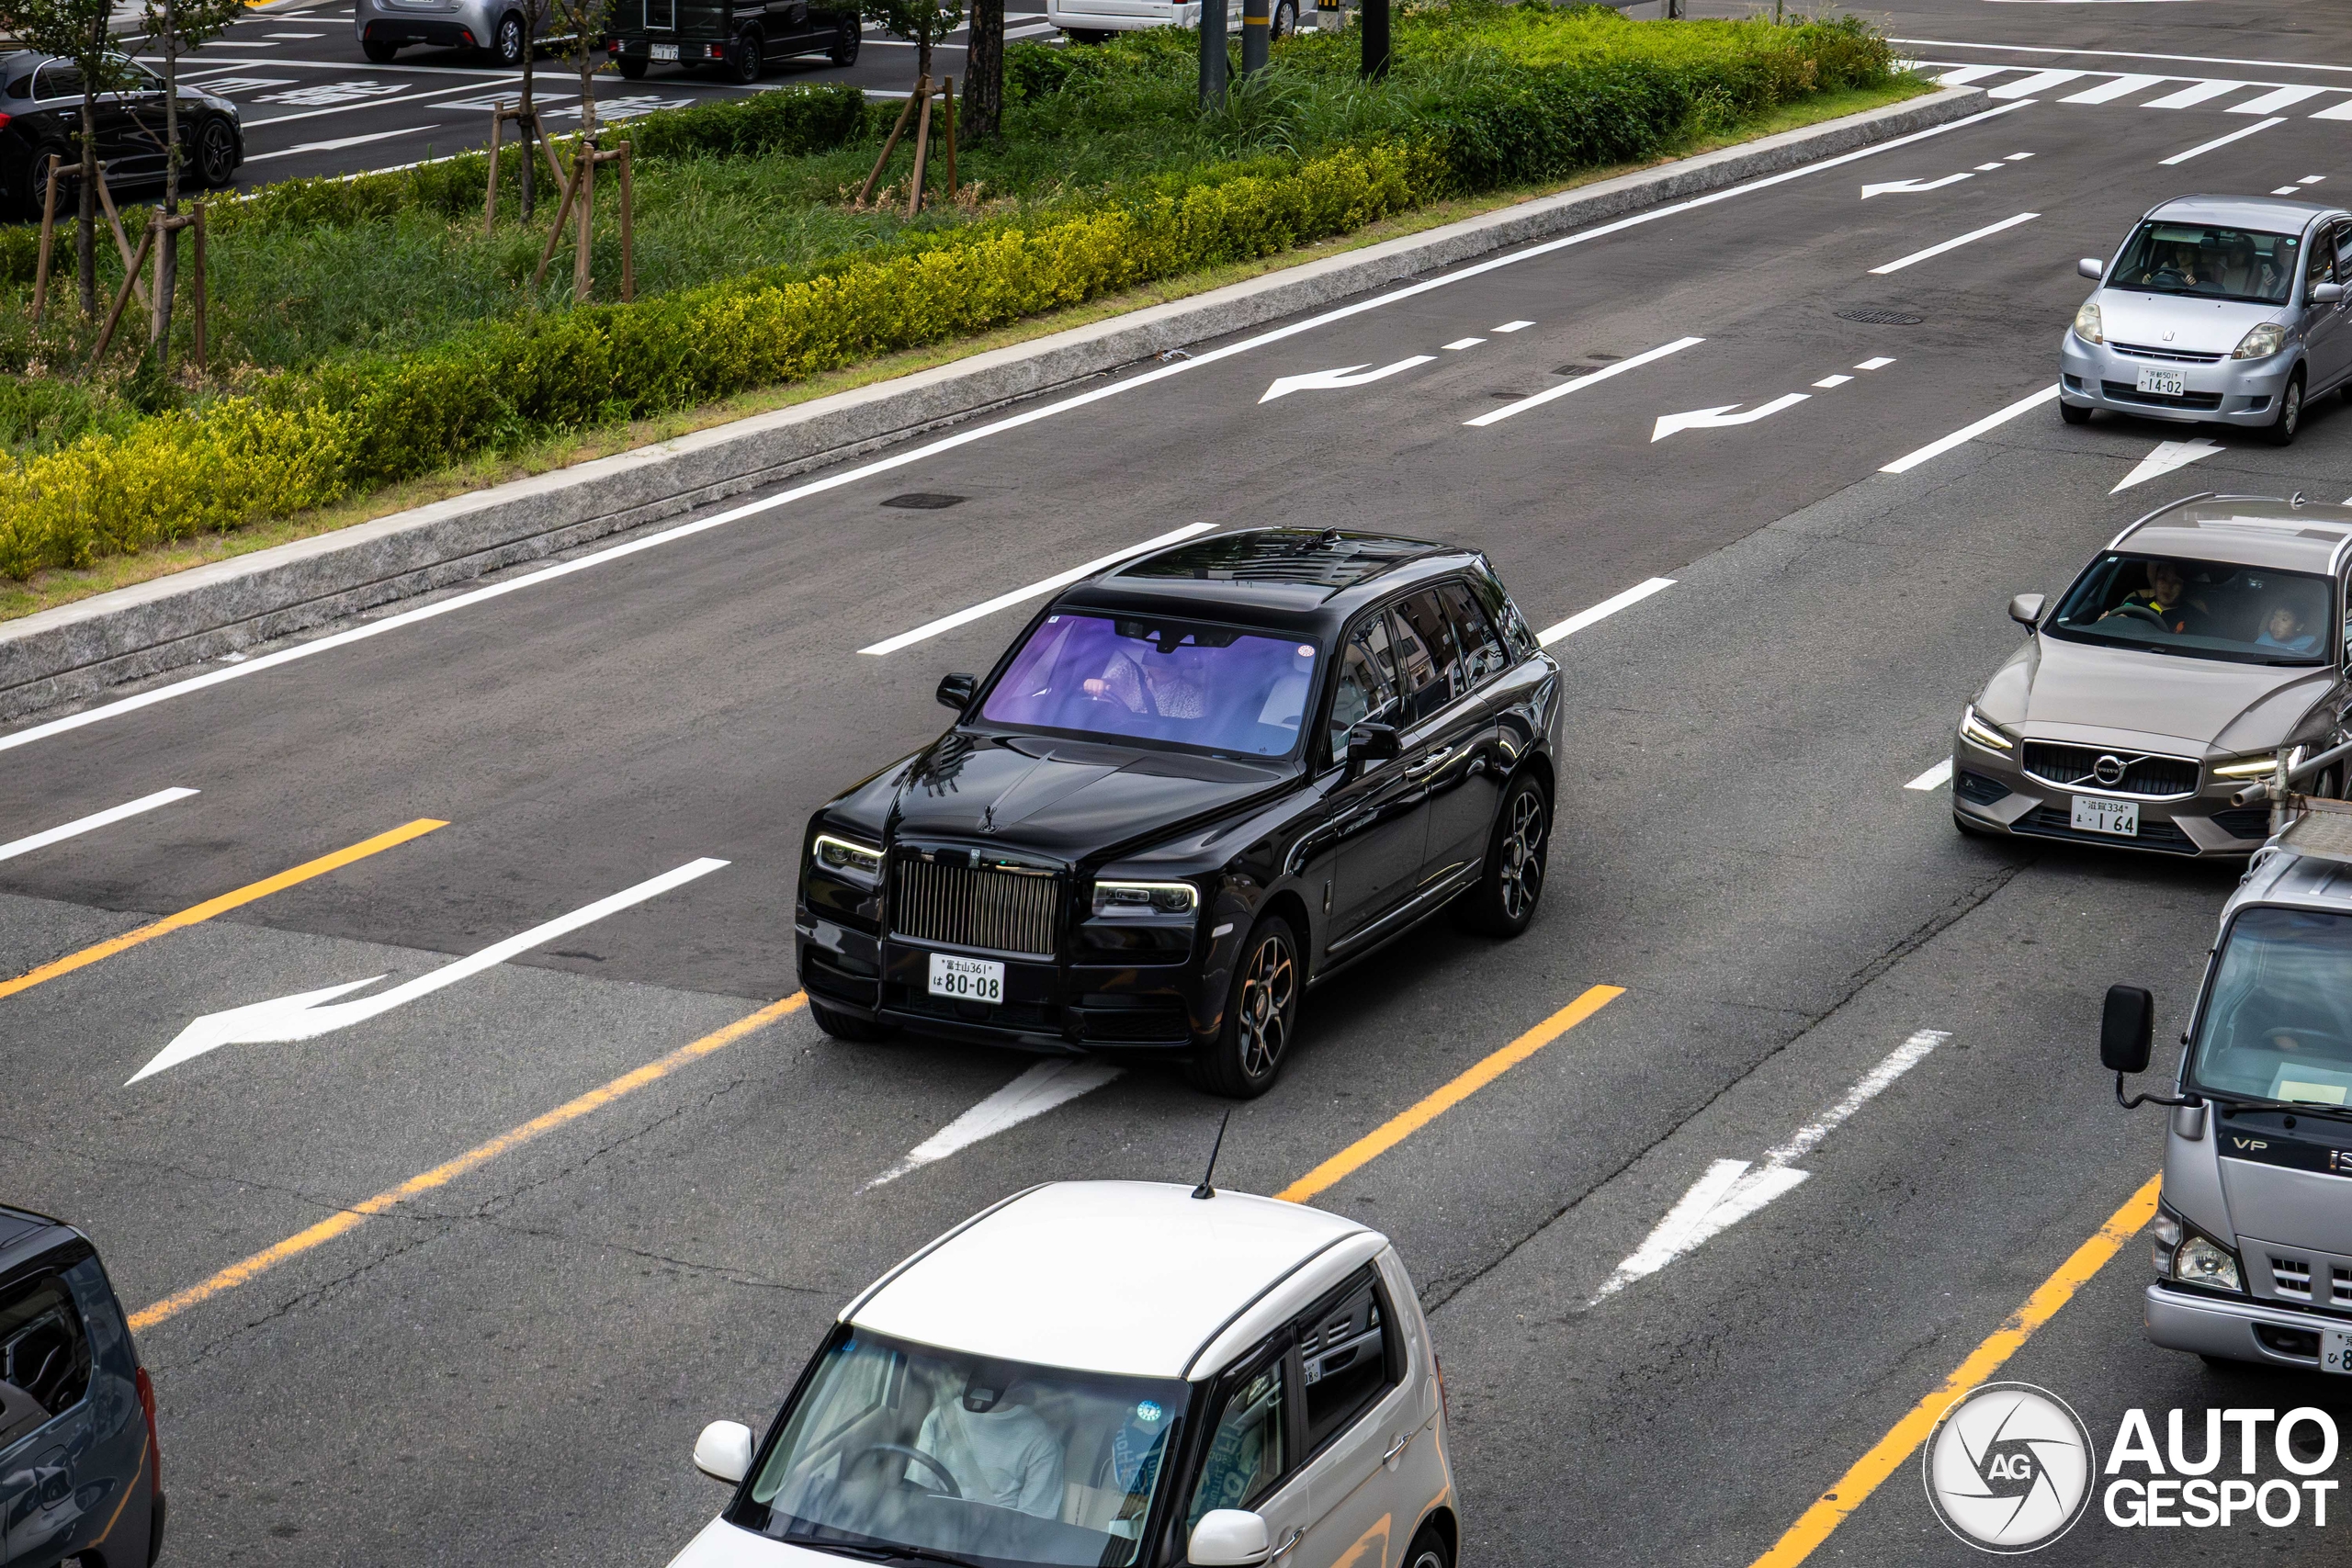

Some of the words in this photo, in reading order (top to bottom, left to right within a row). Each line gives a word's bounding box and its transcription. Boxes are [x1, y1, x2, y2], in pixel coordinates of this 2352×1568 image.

[2149, 370, 2174, 379] 京都501
[2149, 378, 2182, 393] 14-02
[2087, 800, 2124, 813] 滋賀334
[946, 959, 987, 975] 富士山361
[933, 976, 943, 986] は
[945, 972, 1000, 998] 80-08
[2233, 1136, 2268, 1151] VP
[2327, 1352, 2339, 1364] ひ
